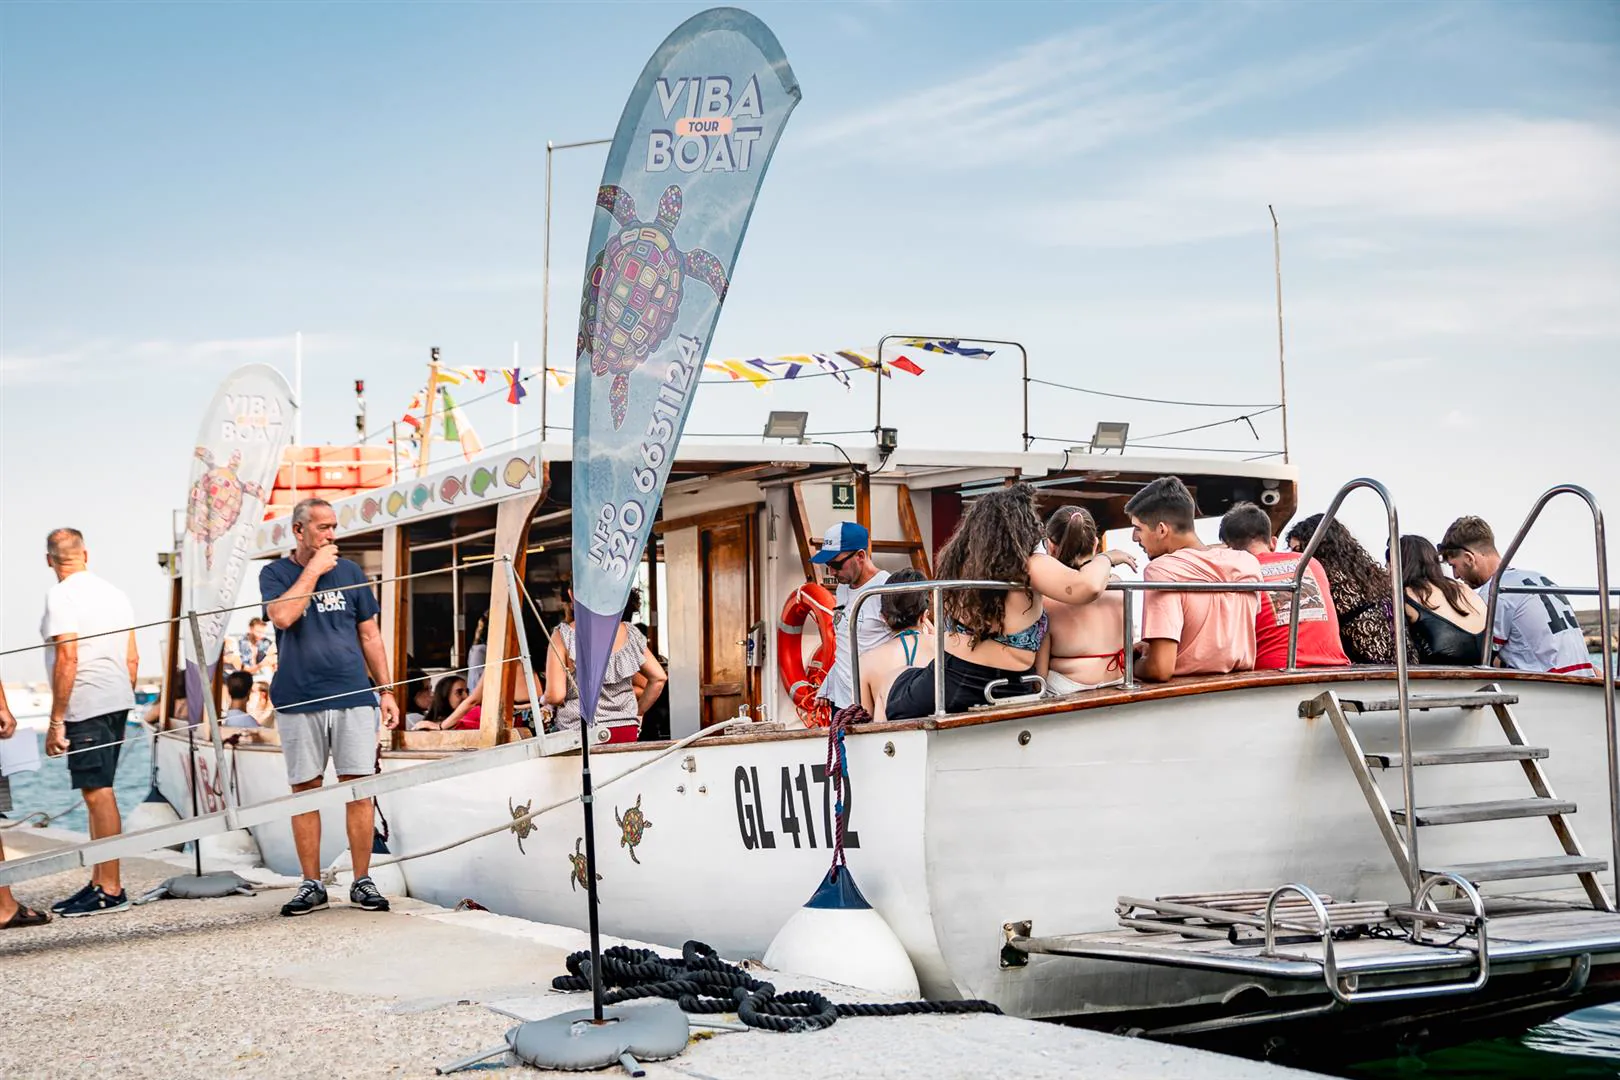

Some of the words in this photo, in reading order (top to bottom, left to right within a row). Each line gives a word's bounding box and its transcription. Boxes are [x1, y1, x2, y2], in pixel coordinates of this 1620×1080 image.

[655, 72, 764, 120] VIBA
[645, 127, 763, 173] BOAT
[688, 121, 719, 132] TOUR
[602, 499, 645, 583] 320
[631, 333, 702, 494] 6631124
[587, 502, 617, 567] INFO
[316, 601, 346, 612] BOAT
[734, 765, 776, 851] GL
[781, 764, 860, 849] 4172
